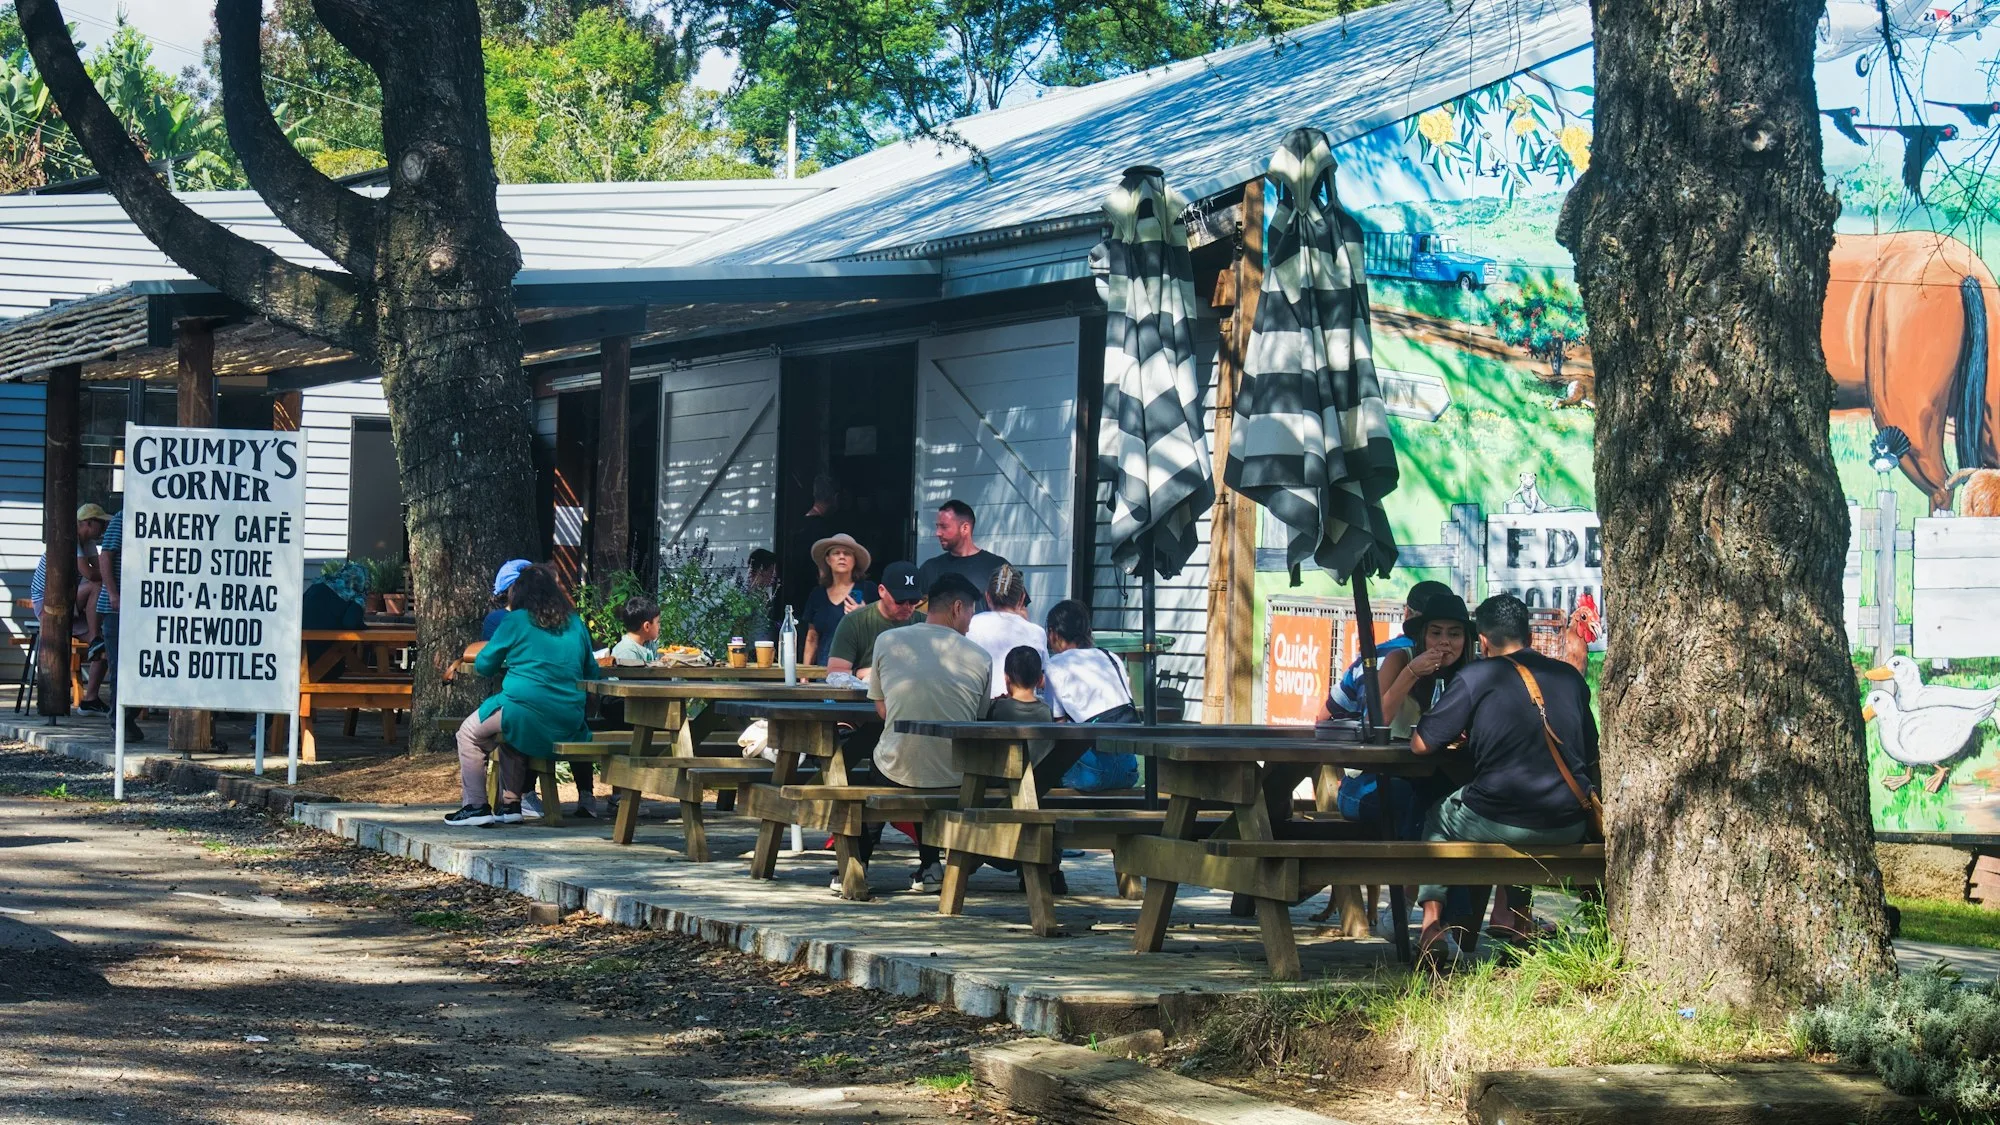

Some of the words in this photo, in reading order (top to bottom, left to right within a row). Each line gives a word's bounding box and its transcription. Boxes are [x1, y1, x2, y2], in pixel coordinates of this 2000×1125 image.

[1923, 12, 1937, 22] 24
[133, 436, 297, 479] GRUMPY'S
[152, 470, 272, 502] CORNER
[135, 512, 220, 541] BAKERY
[149, 547, 201, 575] FEED
[211, 549, 273, 577] STORE
[156, 616, 262, 646] FIREWOOD
[139, 650, 180, 678] GAS
[188, 651, 277, 681] BOTTLES
[1274, 633, 1320, 670] Quick
[1274, 669, 1315, 706] swap
